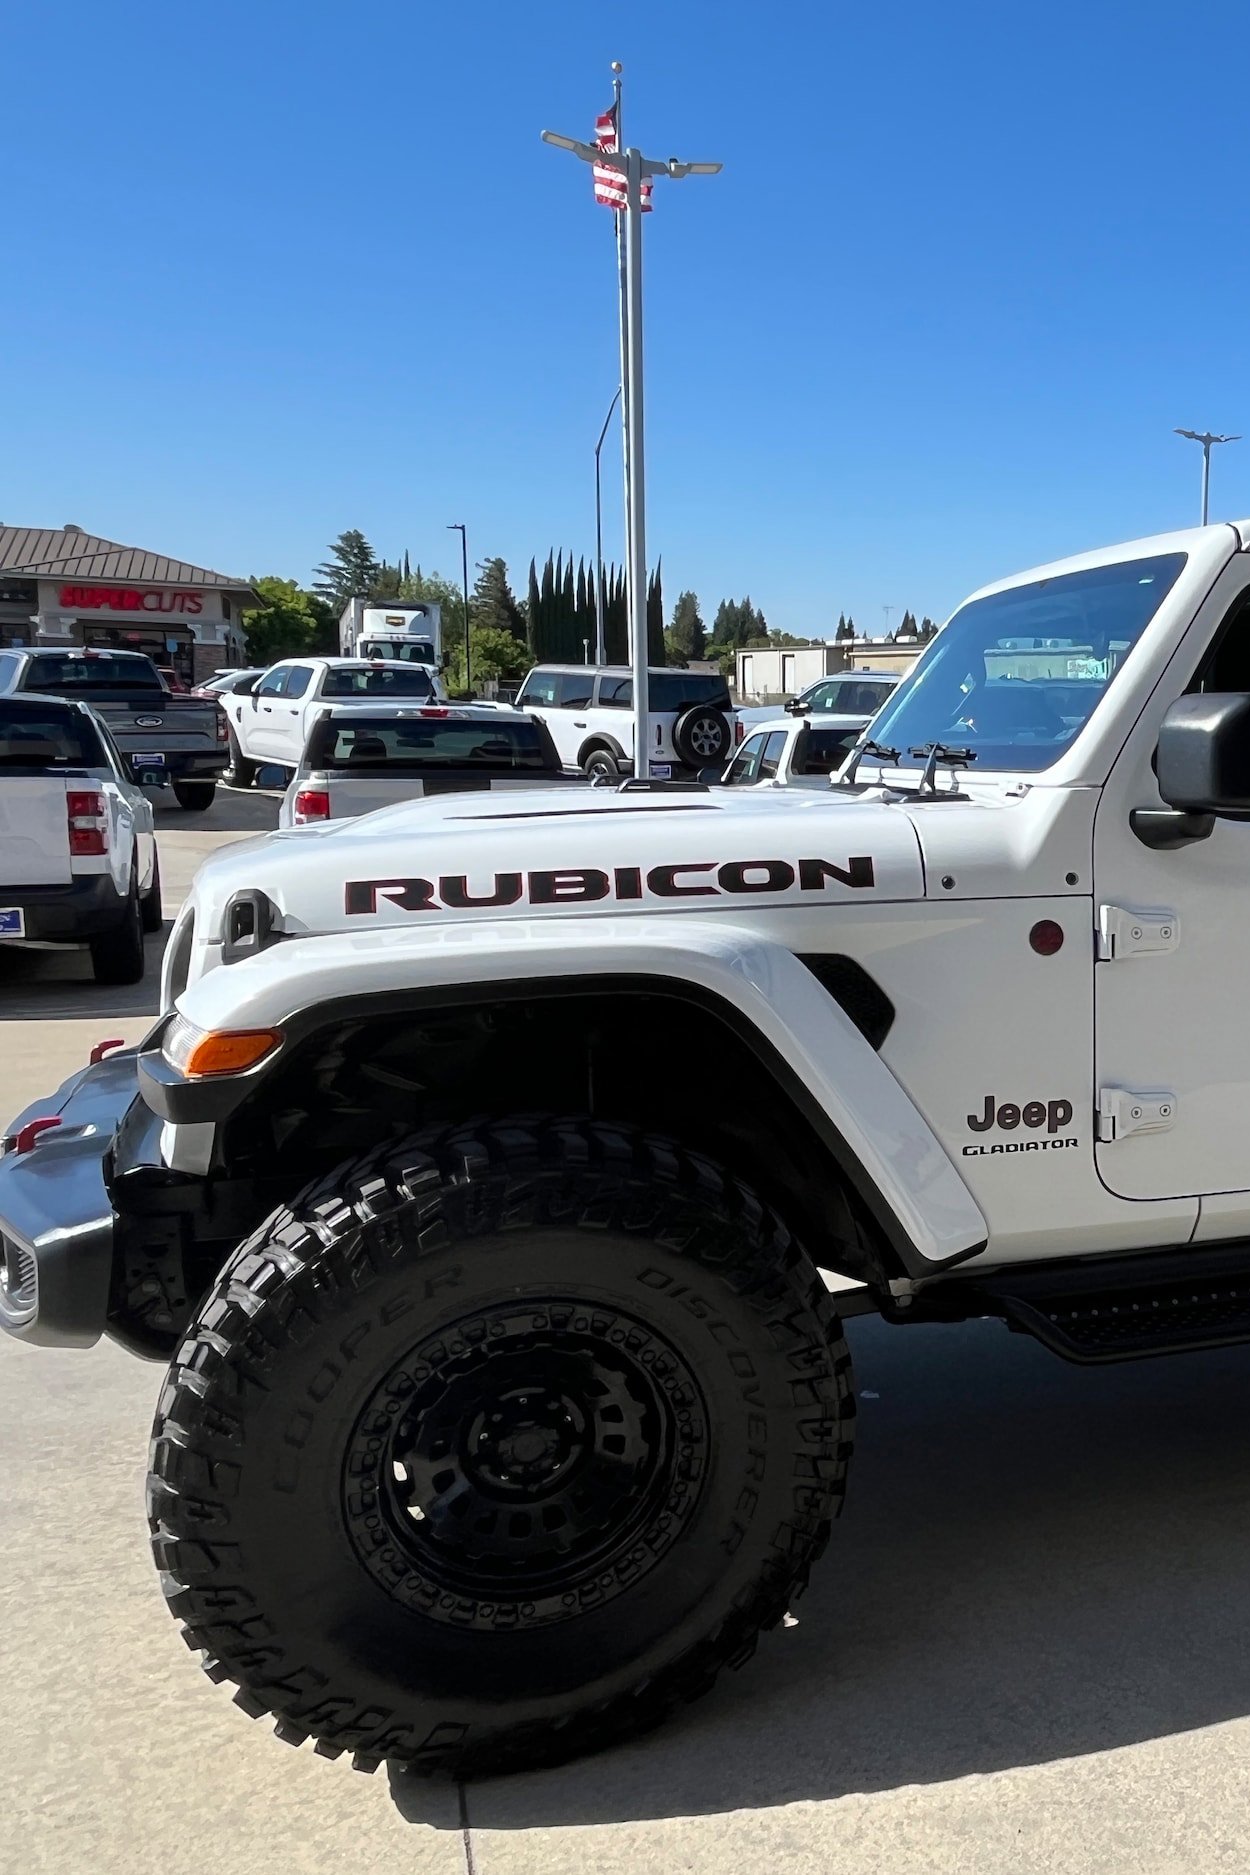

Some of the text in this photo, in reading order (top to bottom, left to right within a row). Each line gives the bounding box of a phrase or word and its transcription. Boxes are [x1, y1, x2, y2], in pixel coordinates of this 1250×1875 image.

[346, 857, 875, 915] RUBICON
[967, 1095, 1073, 1133] Jeep
[962, 1138, 1079, 1156] GLADIATOR
[273, 1263, 463, 1494] COOPER
[637, 1268, 767, 1556] DISCOVERER
